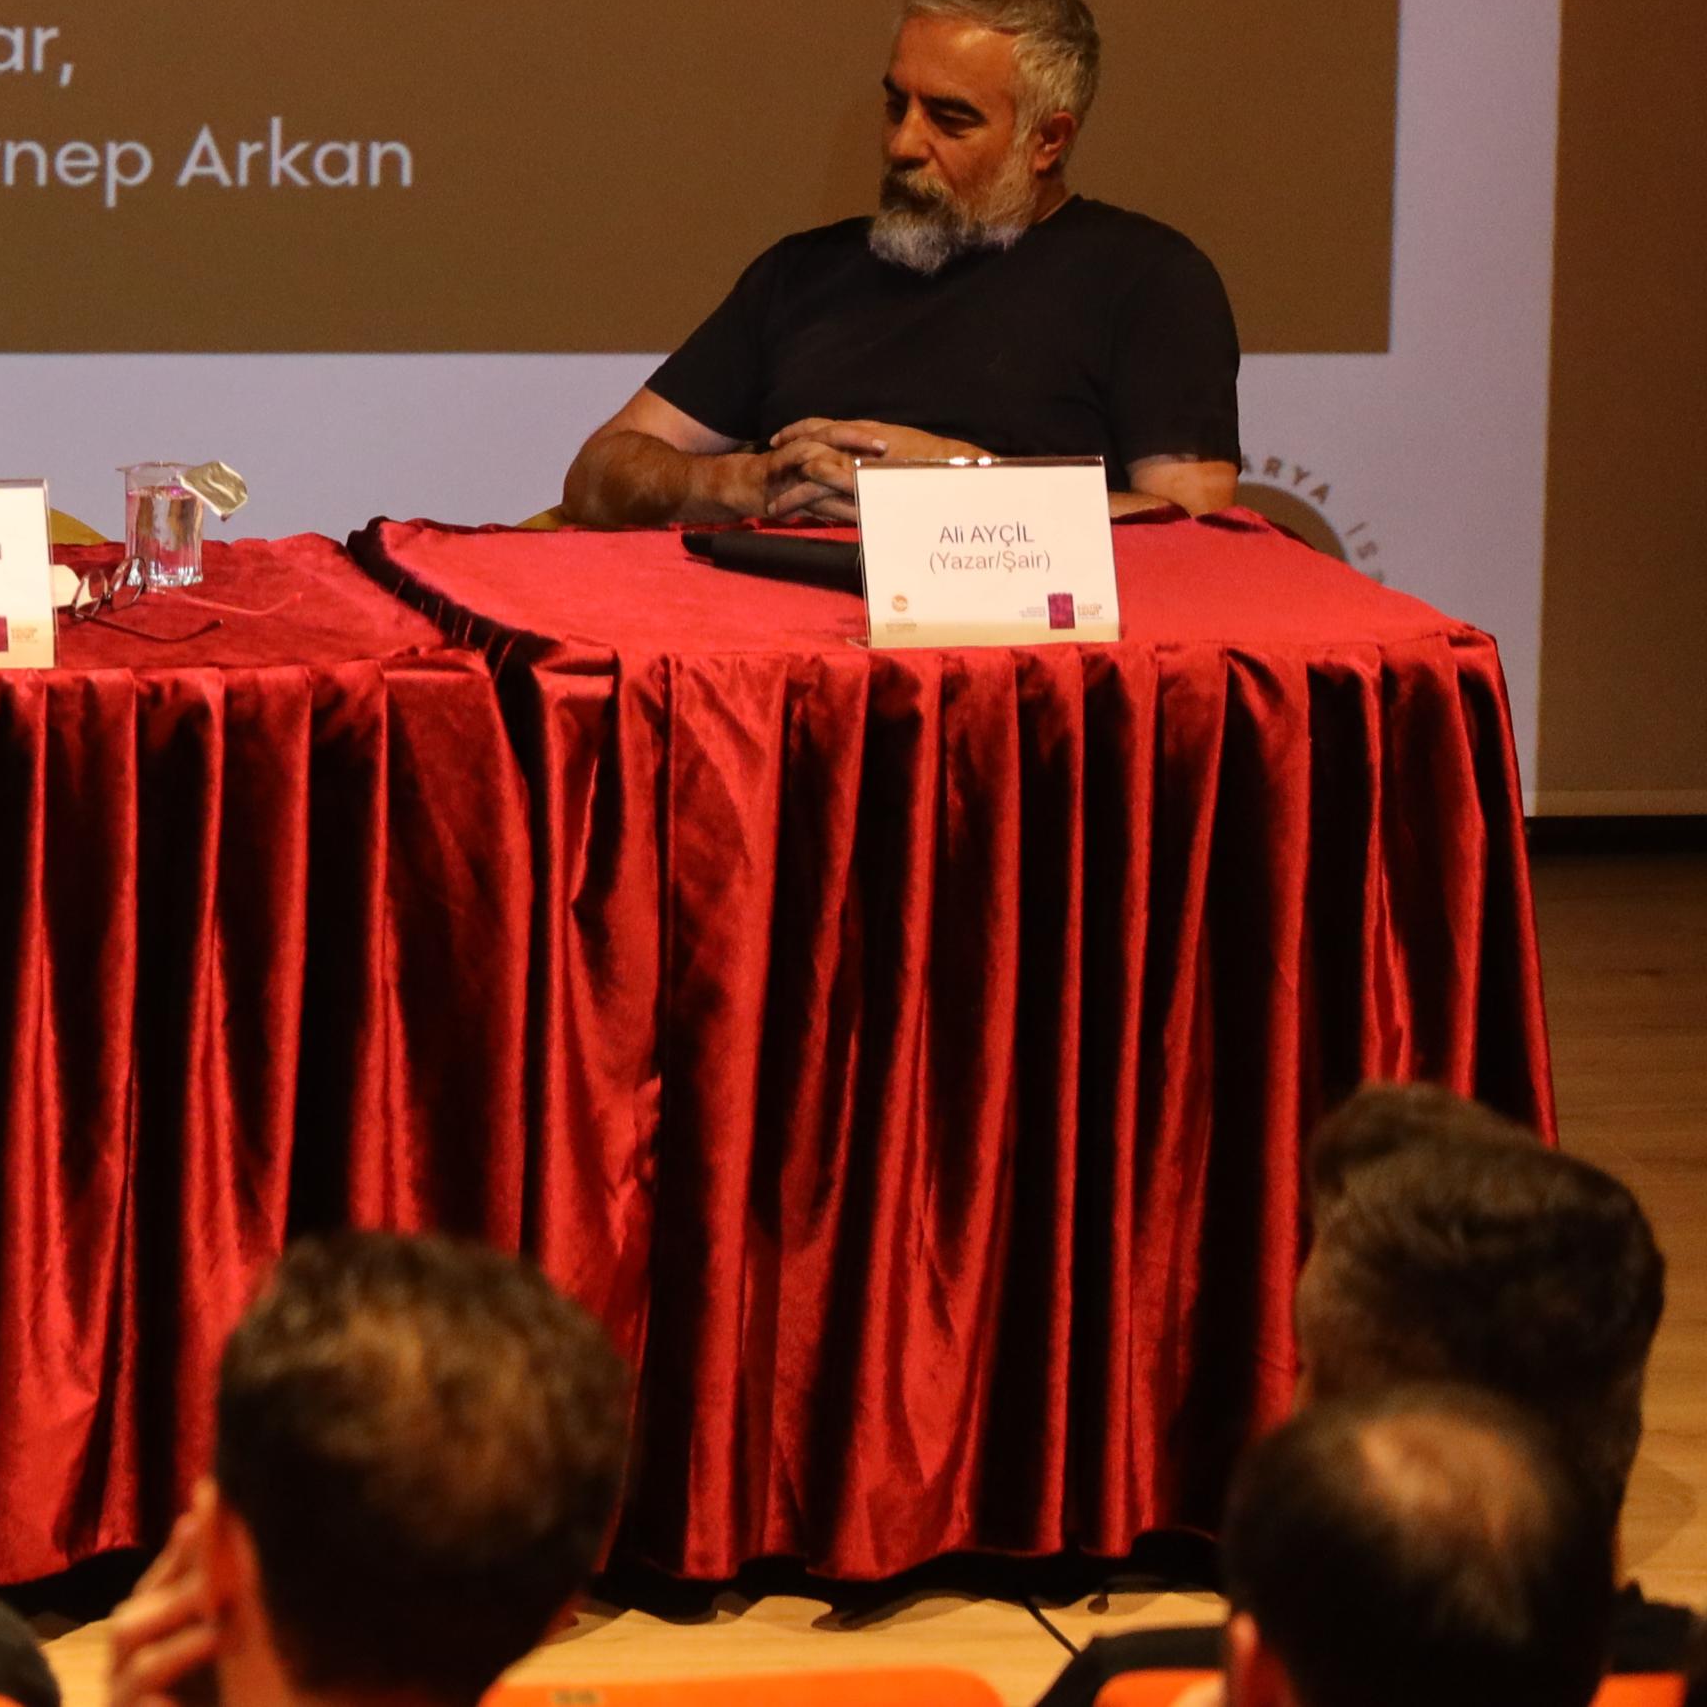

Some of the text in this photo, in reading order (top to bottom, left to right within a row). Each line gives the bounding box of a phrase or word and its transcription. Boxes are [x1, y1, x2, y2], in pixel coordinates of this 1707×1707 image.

[177, 115, 414, 187] Arkan
[939, 525, 965, 544] Ali
[929, 550, 1051, 575] (Yazar/Şair)
